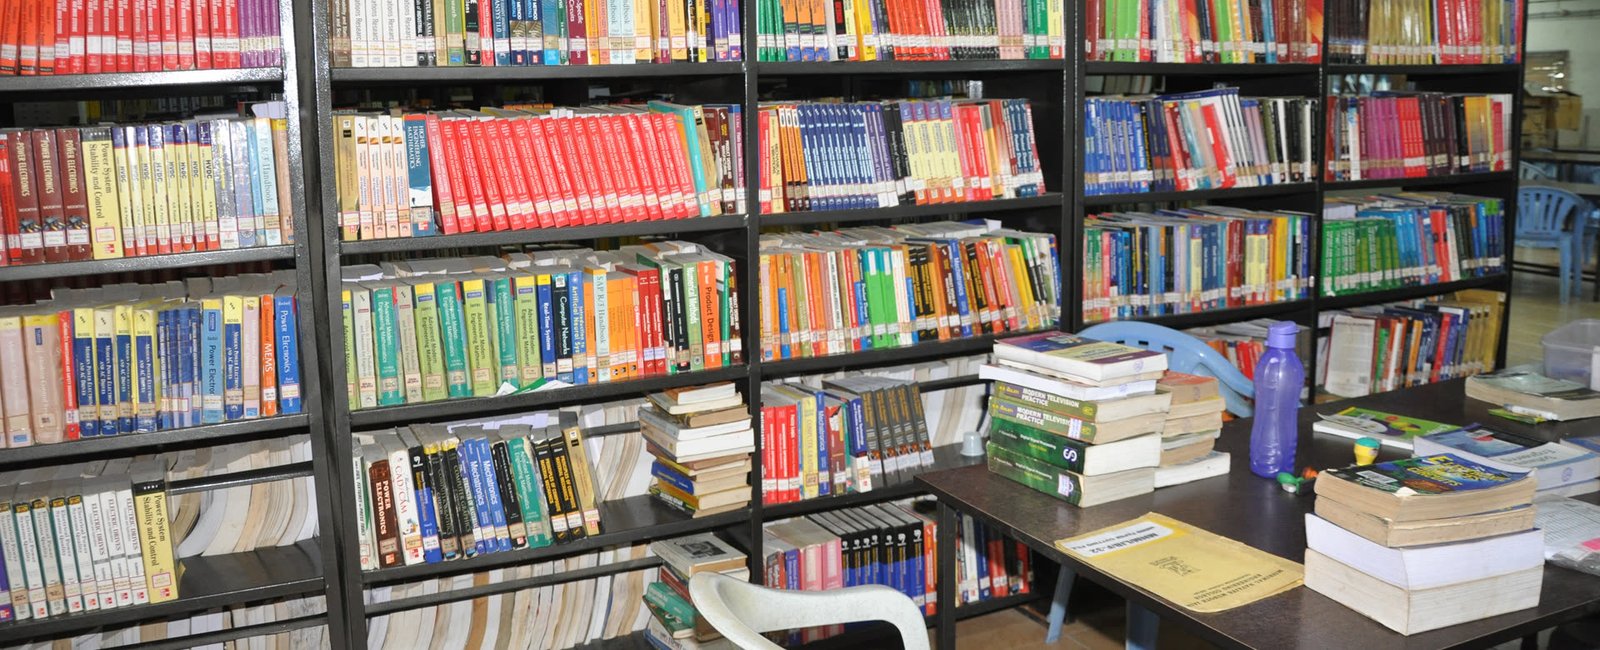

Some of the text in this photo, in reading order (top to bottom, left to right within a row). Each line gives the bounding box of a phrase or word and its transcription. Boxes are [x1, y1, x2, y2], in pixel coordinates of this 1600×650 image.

[623, 0, 631, 25] ndbook
[355, 18, 363, 39] Researc
[88, 143, 100, 175] Stability
[94, 191, 104, 219] Control
[101, 143, 112, 193] Power System
[705, 286, 713, 316] Product
[706, 319, 714, 343] Design
[1016, 407, 1042, 418] MODERN
[1021, 394, 1048, 407] PRACTICE
[1022, 388, 1080, 407] MODERN TELEVISION
[1016, 413, 1045, 425] PRACTICE
[383, 480, 391, 510] POWER
[470, 461, 485, 506] Mechatronics
[483, 460, 498, 505] Mechatronics
[154, 495, 166, 542] Power System
[376, 482, 387, 535] ELECTRONICS
[143, 497, 159, 567] Stability and Control
